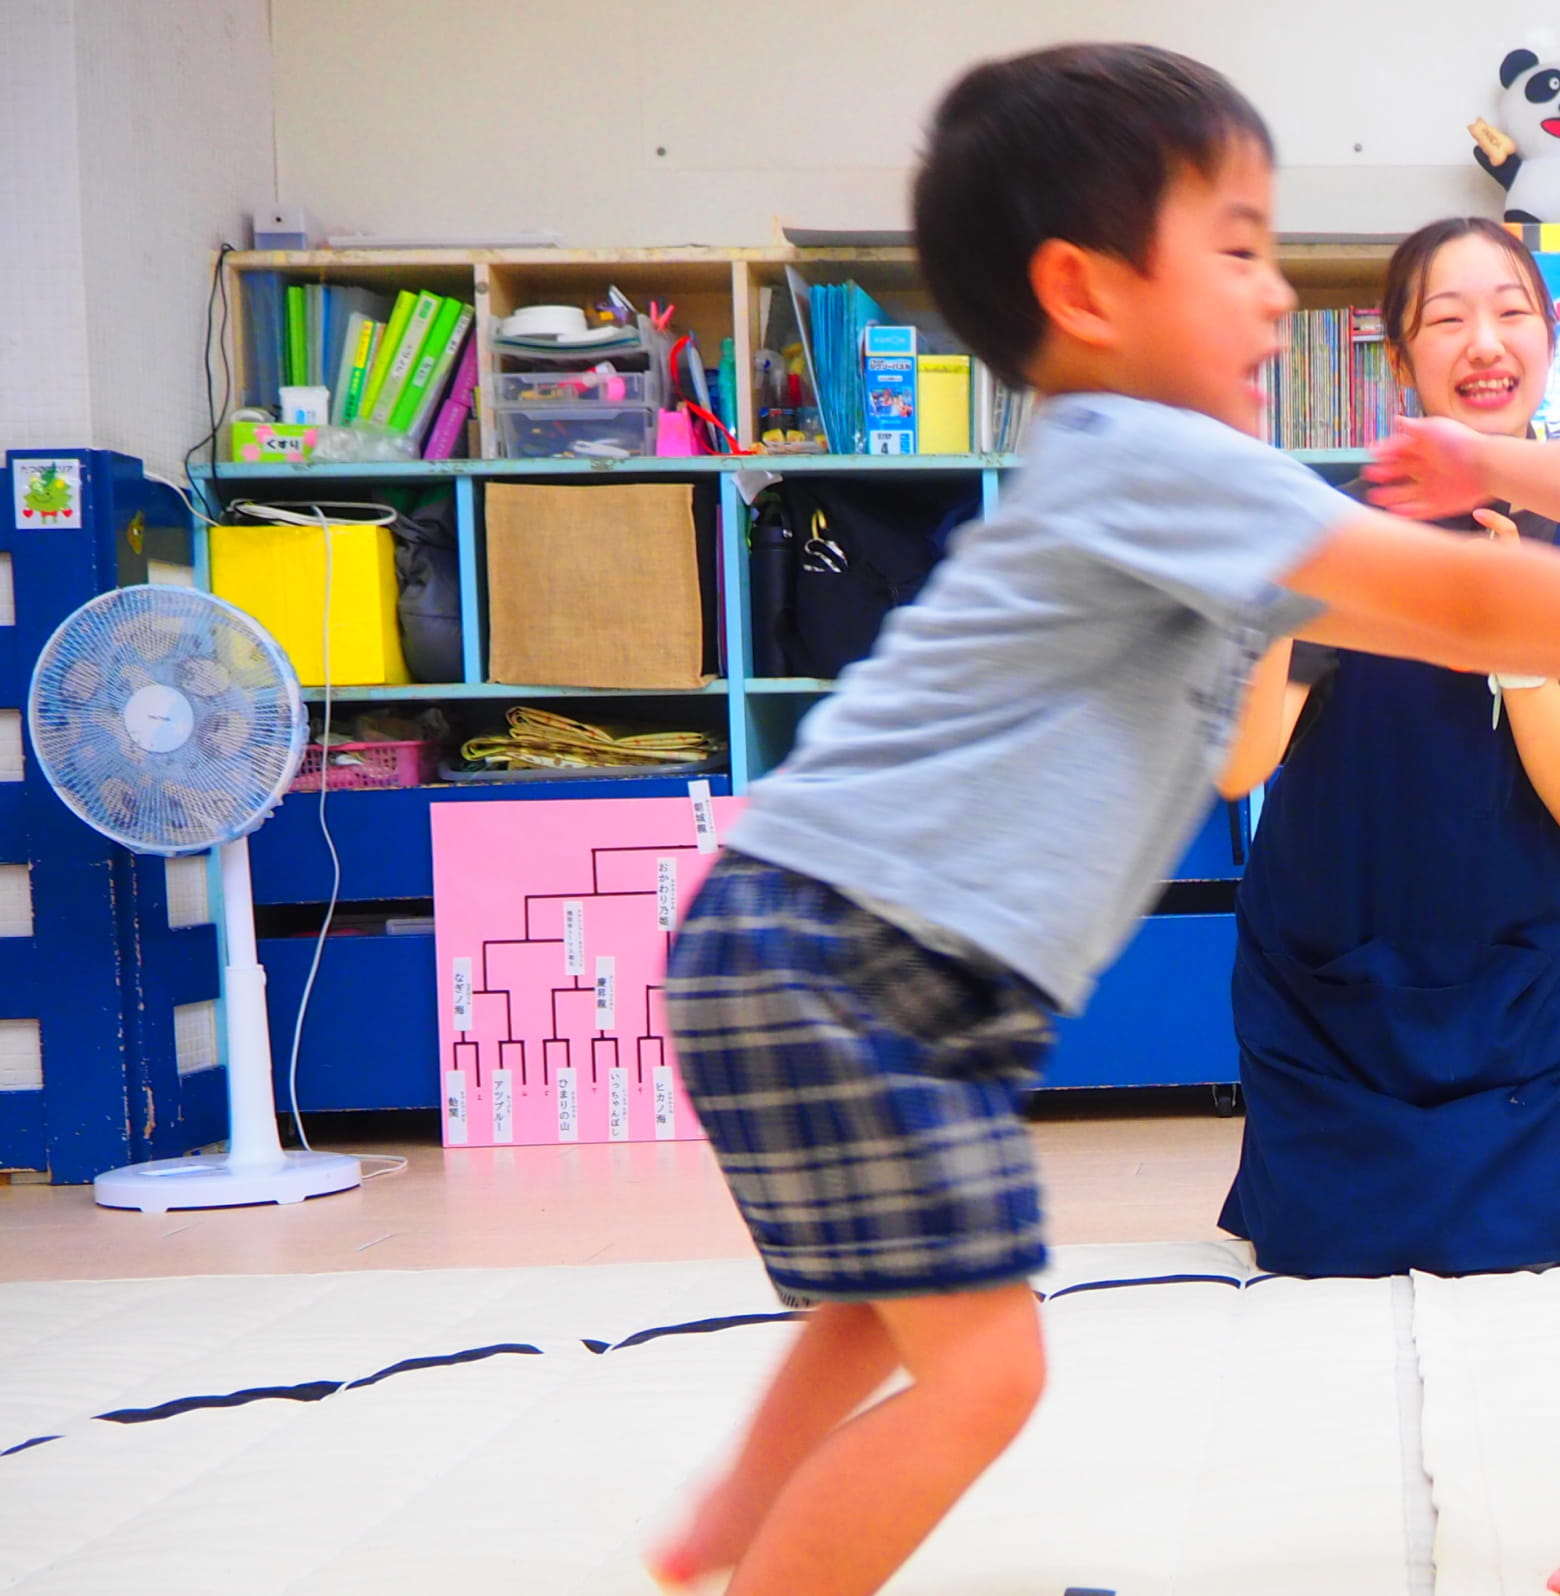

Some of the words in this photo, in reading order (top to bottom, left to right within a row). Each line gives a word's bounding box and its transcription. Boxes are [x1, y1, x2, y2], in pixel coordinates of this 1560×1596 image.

[266, 439, 300, 450] くすり
[881, 442, 889, 455] 4
